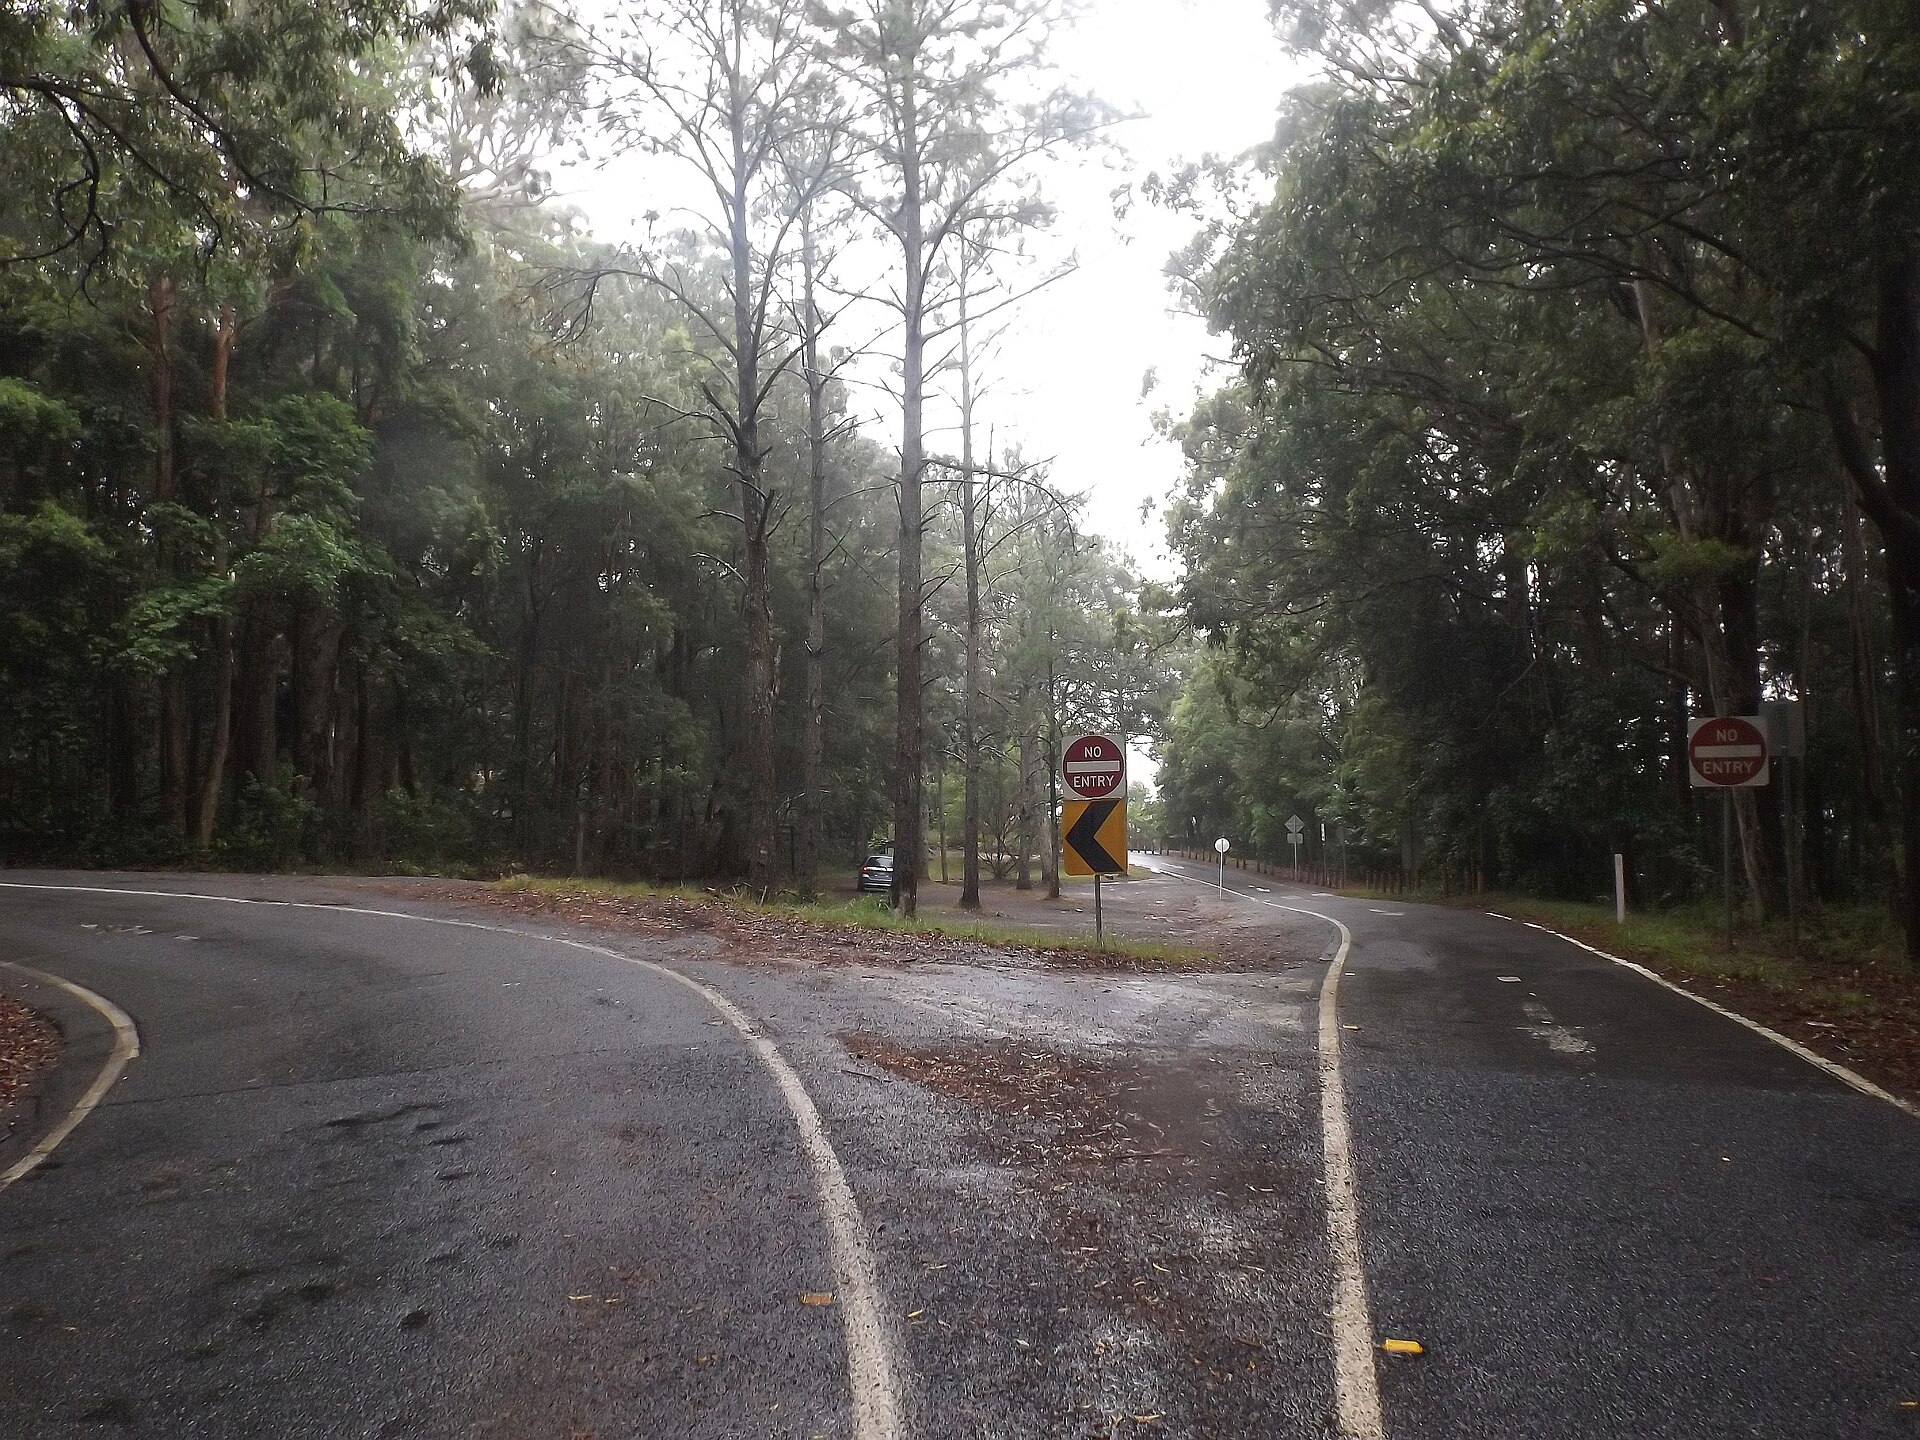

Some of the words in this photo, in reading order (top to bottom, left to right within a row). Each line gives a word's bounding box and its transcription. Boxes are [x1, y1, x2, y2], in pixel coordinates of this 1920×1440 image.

[1716, 728, 1738, 742] NO
[1084, 746, 1102, 758] NO
[1702, 761, 1754, 774] ENTRY
[1073, 775, 1114, 788] ENTRY
